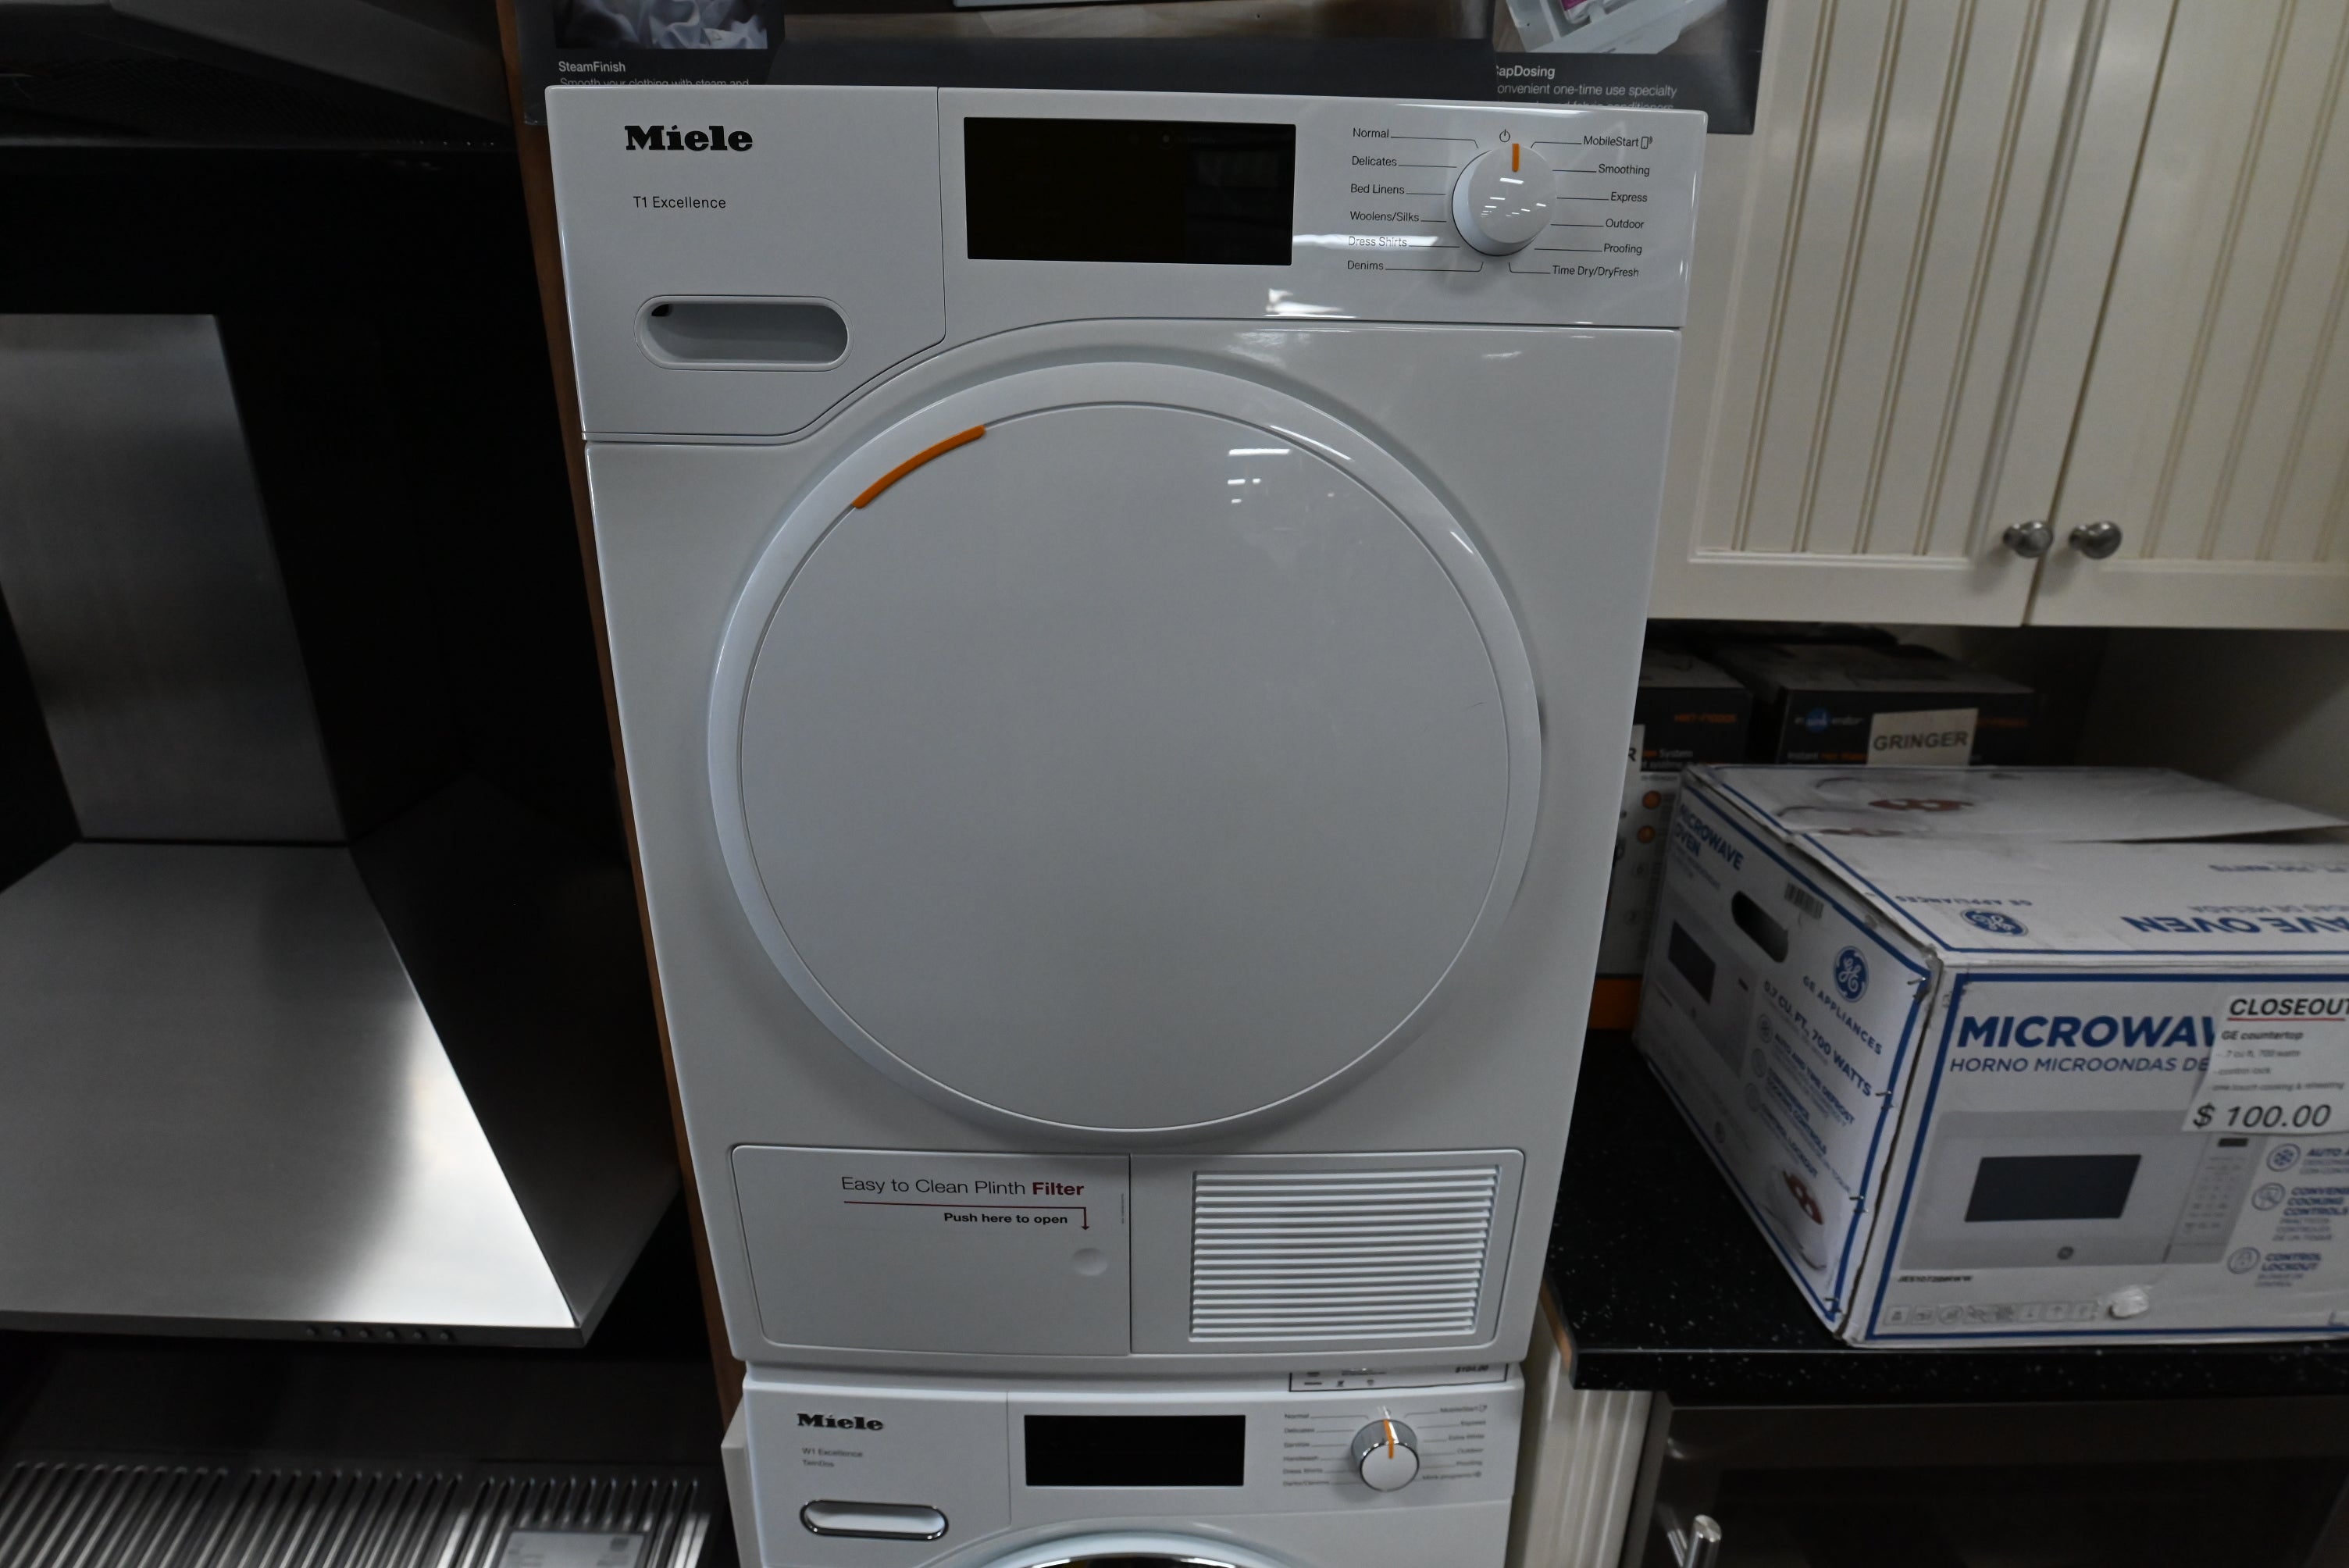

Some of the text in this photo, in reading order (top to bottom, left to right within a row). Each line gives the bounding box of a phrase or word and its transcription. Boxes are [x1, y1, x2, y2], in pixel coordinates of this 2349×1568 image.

[558, 61, 626, 73] SteamFinish
[1497, 83, 1677, 98] onvenient one-time use specialty
[624, 124, 754, 151] Miele
[1353, 127, 1389, 138] Normal
[1583, 135, 1639, 147] MobileStart
[1352, 155, 1397, 166] Delicates
[1598, 163, 1650, 177] Smoothing
[1350, 183, 1405, 194] Bed Linens
[633, 195, 726, 209] T1 Excellence
[1610, 191, 1648, 203] Express
[1349, 211, 1420, 222] Woolens/Silks
[1605, 218, 1645, 229] Outdoor
[1348, 236, 1407, 247] Dress Shirts
[1603, 243, 1642, 255] Proofing
[1347, 260, 1384, 270] Denims
[1552, 265, 1639, 279] Time Dry/DryFresh
[1873, 731, 1969, 751] GRINGER
[1674, 821, 1702, 856] OVEN
[1680, 804, 1744, 871] MICROWAVE
[2119, 916, 2261, 933] OVEN
[1802, 975, 1883, 1055] GE APPLIANCES
[2221, 1030, 2304, 1041] GE countertop
[1812, 1028, 1831, 1055] 700
[1834, 1050, 1872, 1096] WATTS
[1950, 1057, 2209, 1072] HORNO MICROONDAS DE
[2192, 1102, 2332, 1129] $ 100.00
[841, 1176, 1085, 1196] Easy to Clean Plinth Filter
[943, 1213, 1068, 1225] Push here to open
[797, 1413, 884, 1431] Miele
